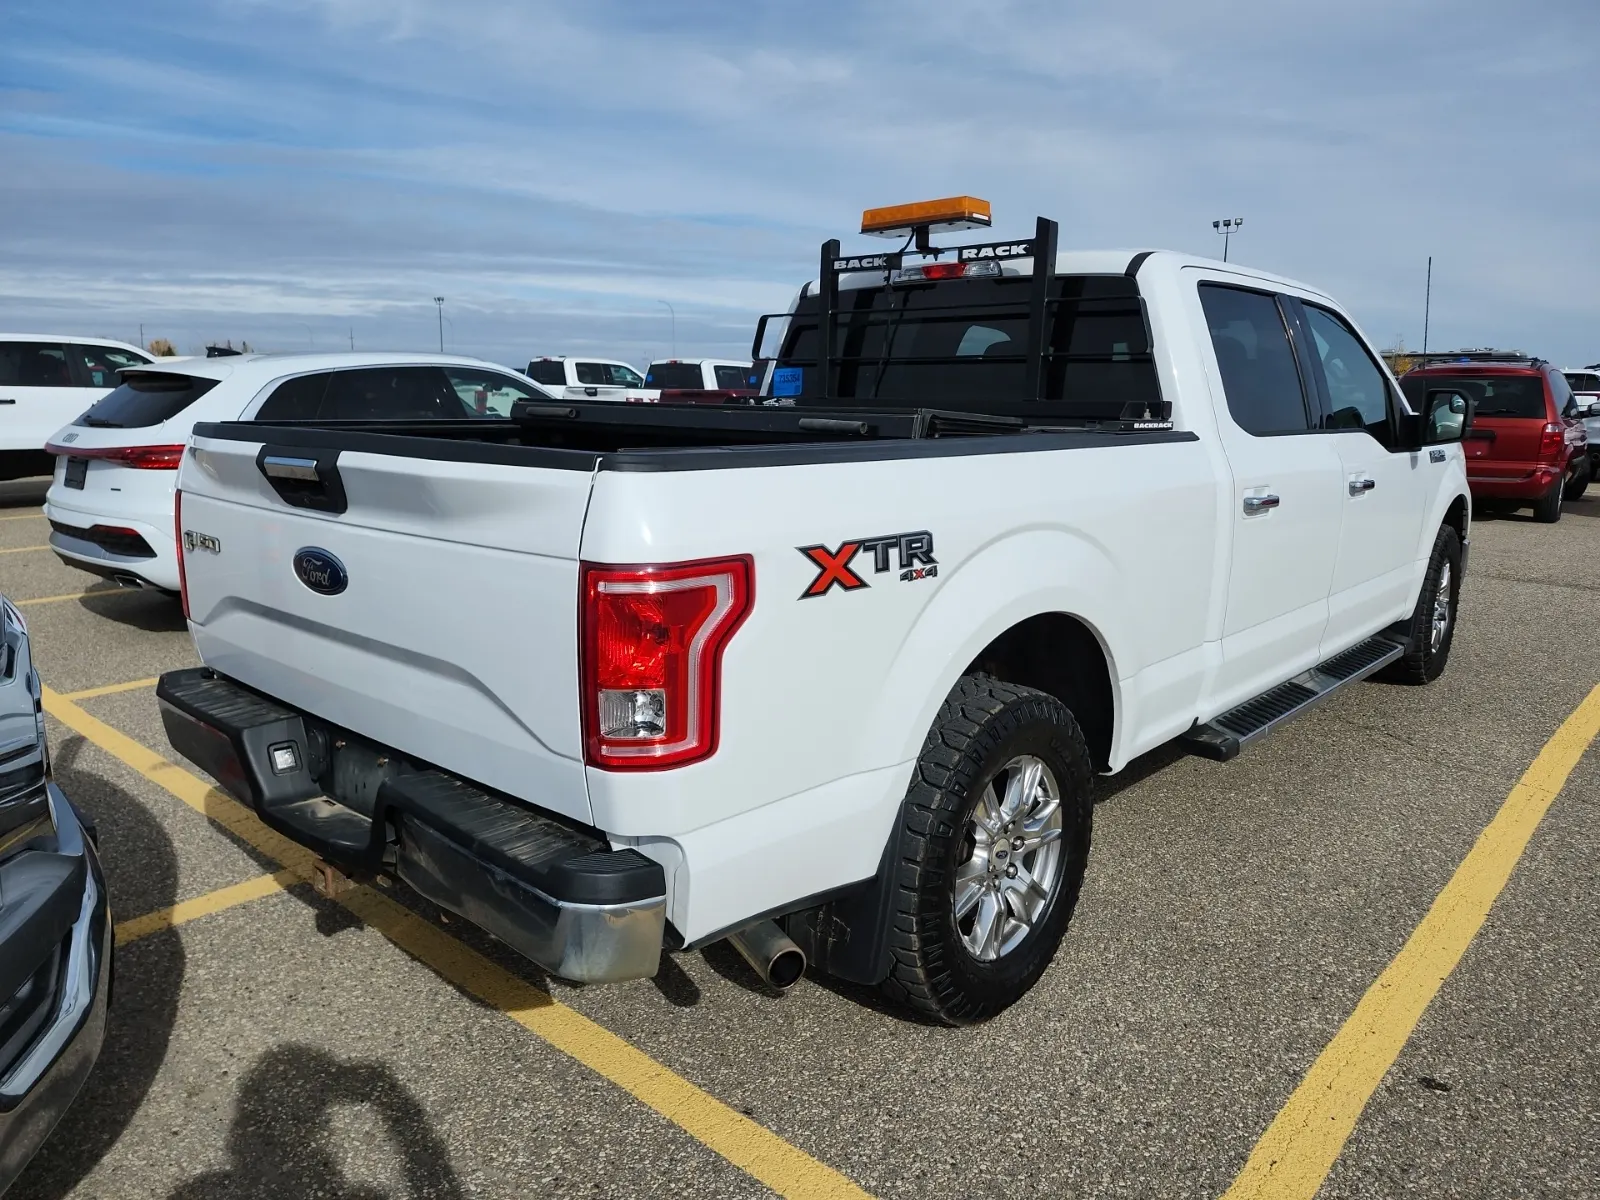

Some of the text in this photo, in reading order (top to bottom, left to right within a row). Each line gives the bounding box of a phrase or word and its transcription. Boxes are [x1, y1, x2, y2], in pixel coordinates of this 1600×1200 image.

[833, 243, 1027, 270] BACK RACK
[301, 556, 331, 586] Ford
[794, 529, 940, 601] XTR
